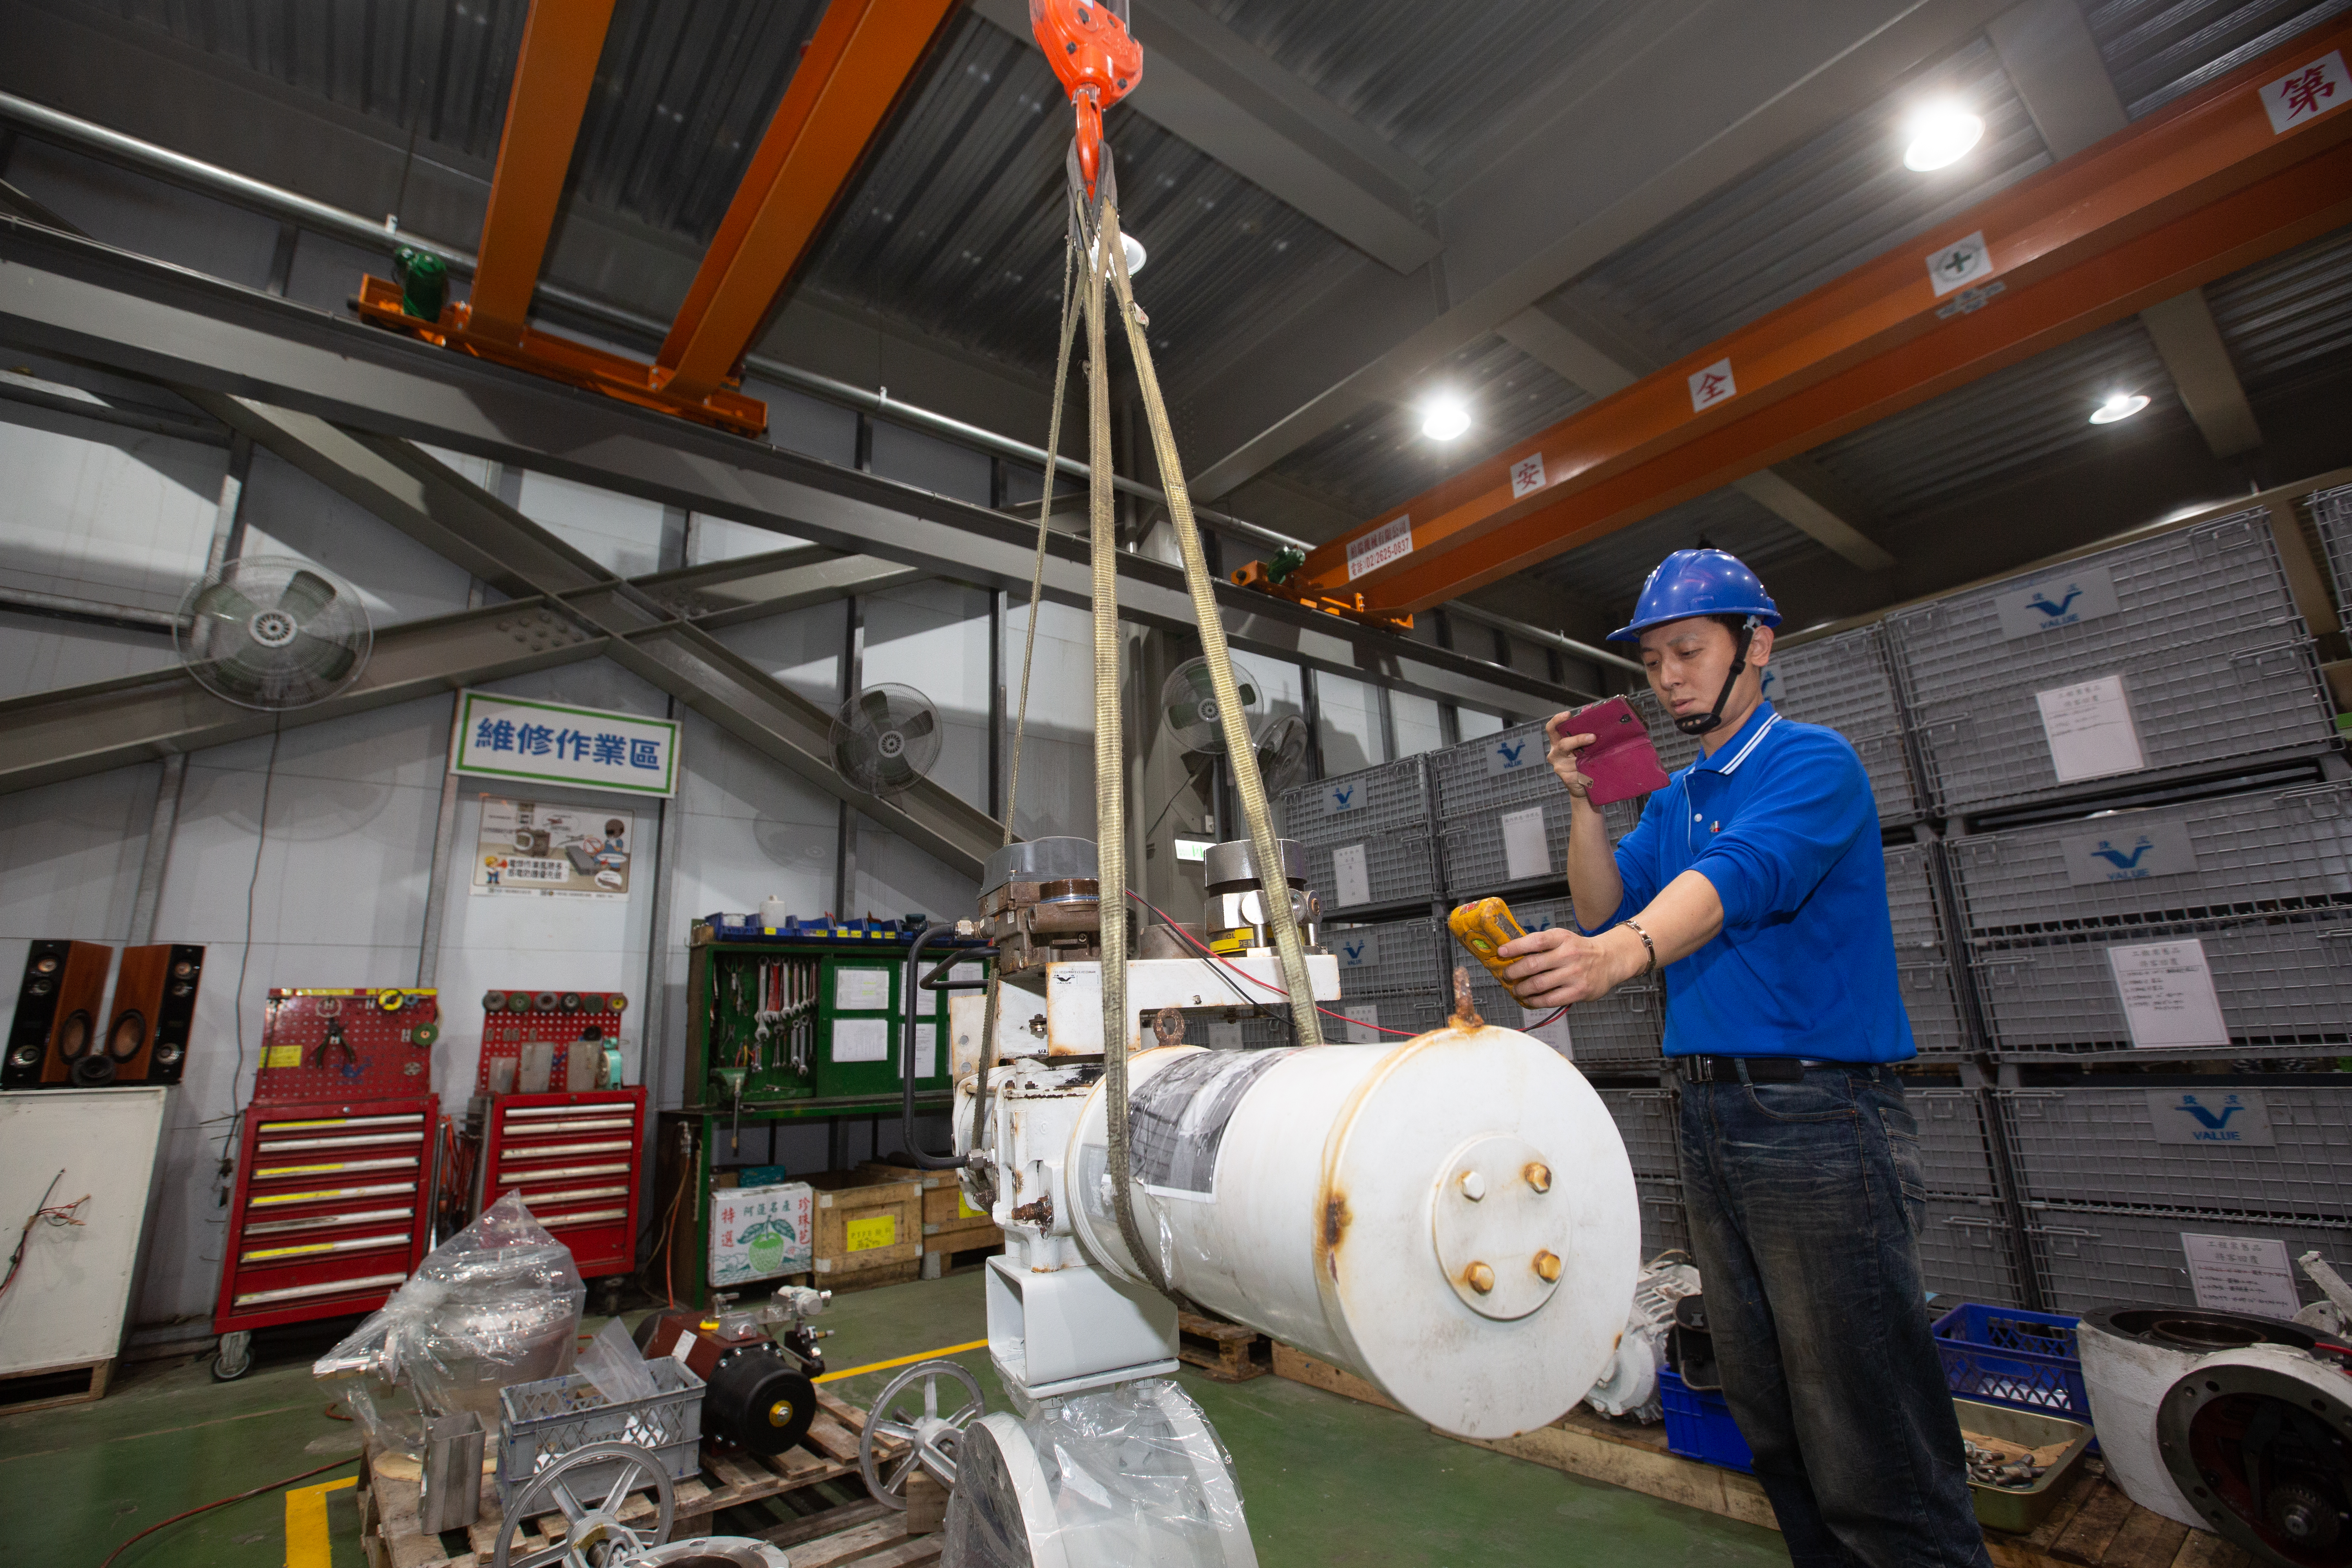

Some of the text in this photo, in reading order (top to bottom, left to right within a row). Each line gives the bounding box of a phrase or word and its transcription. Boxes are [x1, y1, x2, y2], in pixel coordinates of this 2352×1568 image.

[1517, 64, 2336, 490] 安 全 第
[475, 717, 660, 771] 維修作業區
[2192, 1131, 2242, 1141] VALUE
[721, 1206, 735, 1248] 特選
